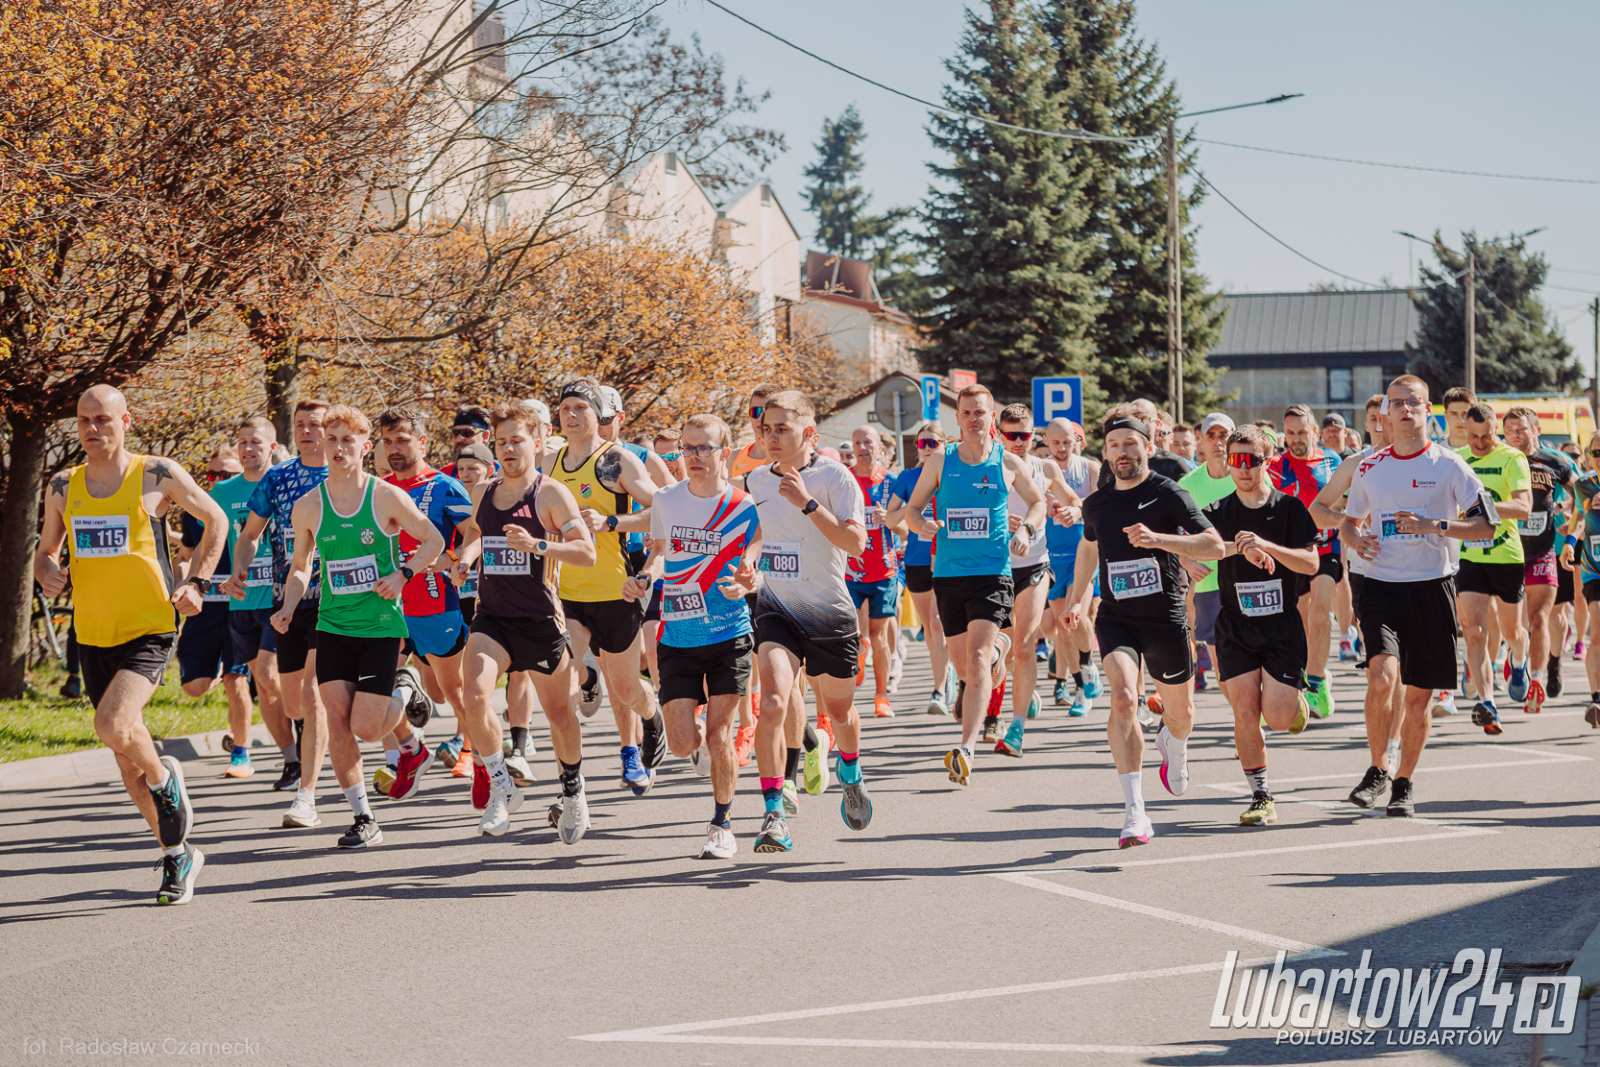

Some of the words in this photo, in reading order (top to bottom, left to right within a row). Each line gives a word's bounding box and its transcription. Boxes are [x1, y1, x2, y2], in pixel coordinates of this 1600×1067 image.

[926, 380, 935, 406] P
[1043, 382, 1072, 422] P
[964, 518, 987, 530] 097
[97, 529, 124, 547] 115
[671, 525, 721, 543] NIEMCE
[683, 540, 720, 555] TEAM
[500, 549, 525, 565] 139
[773, 555, 797, 571] 080
[350, 567, 375, 584] 108
[1131, 568, 1157, 587] 123
[676, 594, 701, 611] 138
[1256, 591, 1278, 607] 161
